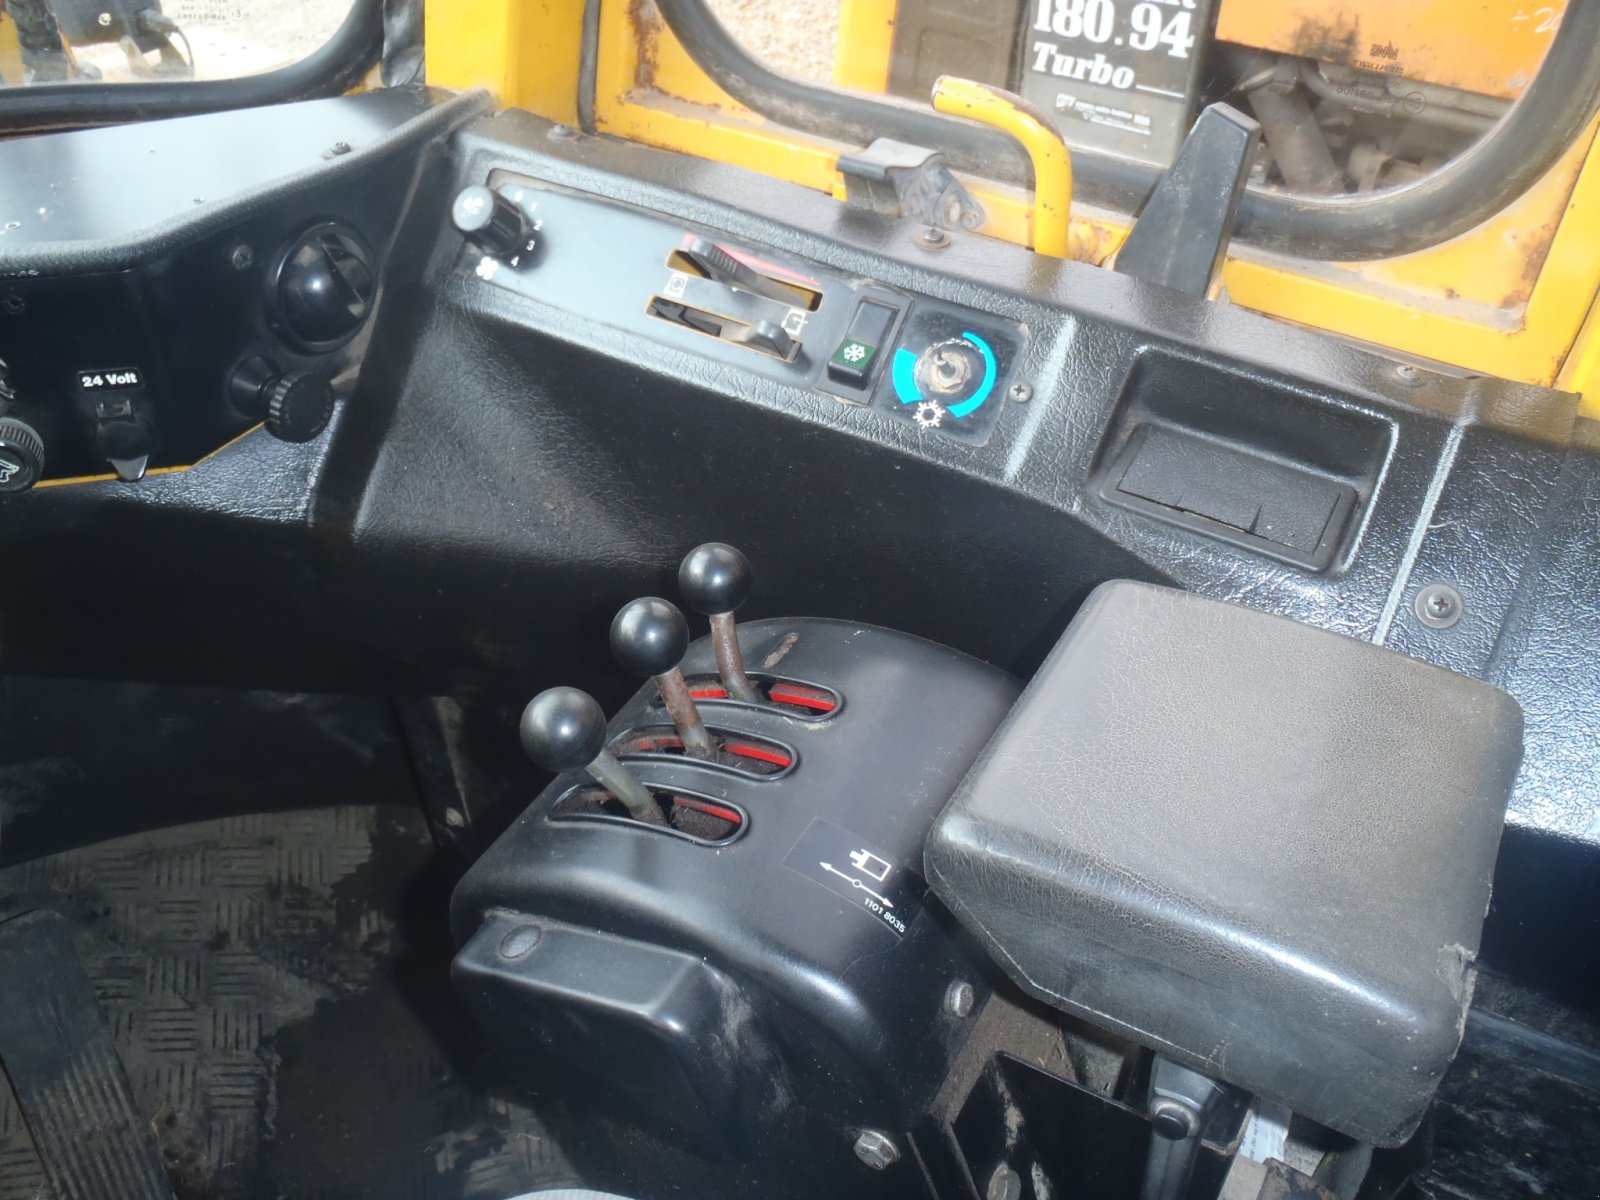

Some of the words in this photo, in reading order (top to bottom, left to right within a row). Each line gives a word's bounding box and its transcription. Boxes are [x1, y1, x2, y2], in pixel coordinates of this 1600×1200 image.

[1033, 0, 1195, 58] 180.94
[1032, 41, 1135, 89] Turbo
[533, 219, 543, 231] 2
[526, 240, 536, 251] 3
[510, 256, 519, 267] 4
[82, 374, 104, 388] 24
[105, 372, 138, 385] Volt
[864, 897, 884, 915] 1101
[883, 911, 906, 933] 8035
